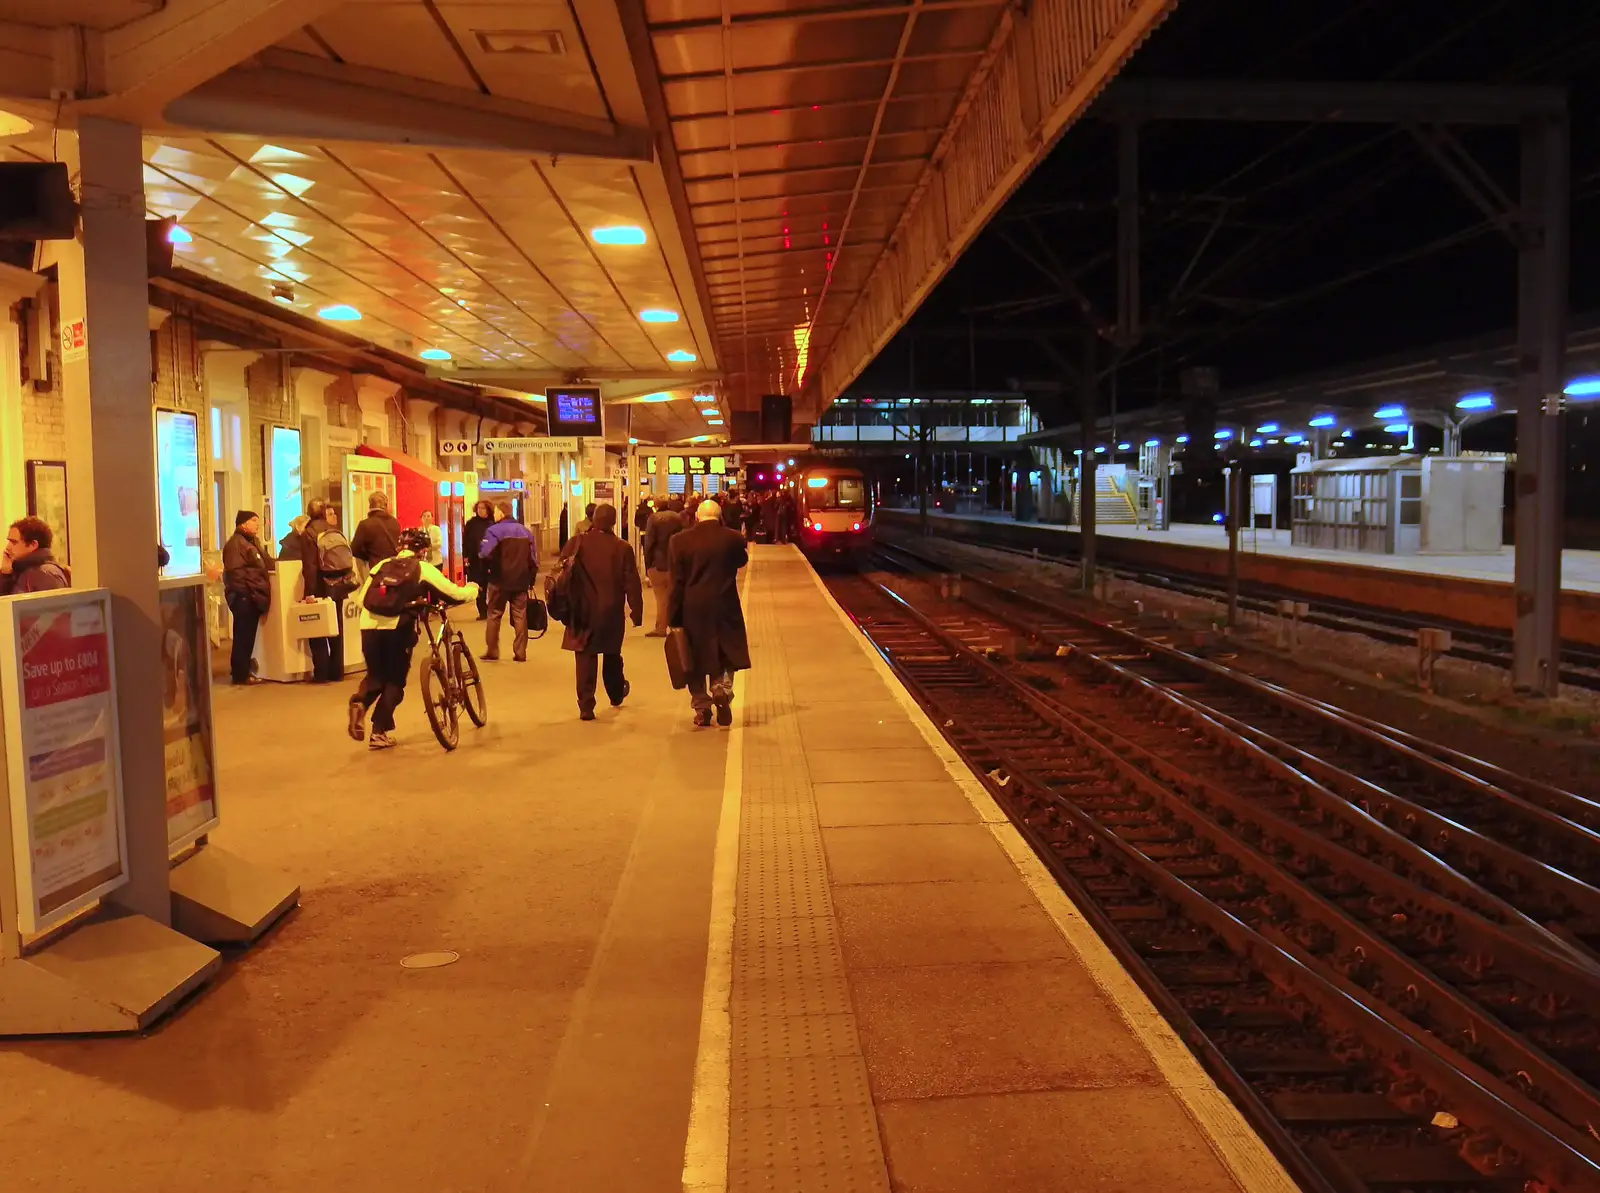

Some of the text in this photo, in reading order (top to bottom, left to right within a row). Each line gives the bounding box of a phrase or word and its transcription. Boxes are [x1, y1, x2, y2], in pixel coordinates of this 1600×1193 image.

[498, 440, 572, 450] Engineering notices
[728, 456, 736, 464] 4
[1301, 456, 1306, 464] 7
[24, 662, 49, 679] Save
[50, 660, 63, 677] up
[65, 657, 75, 671] to
